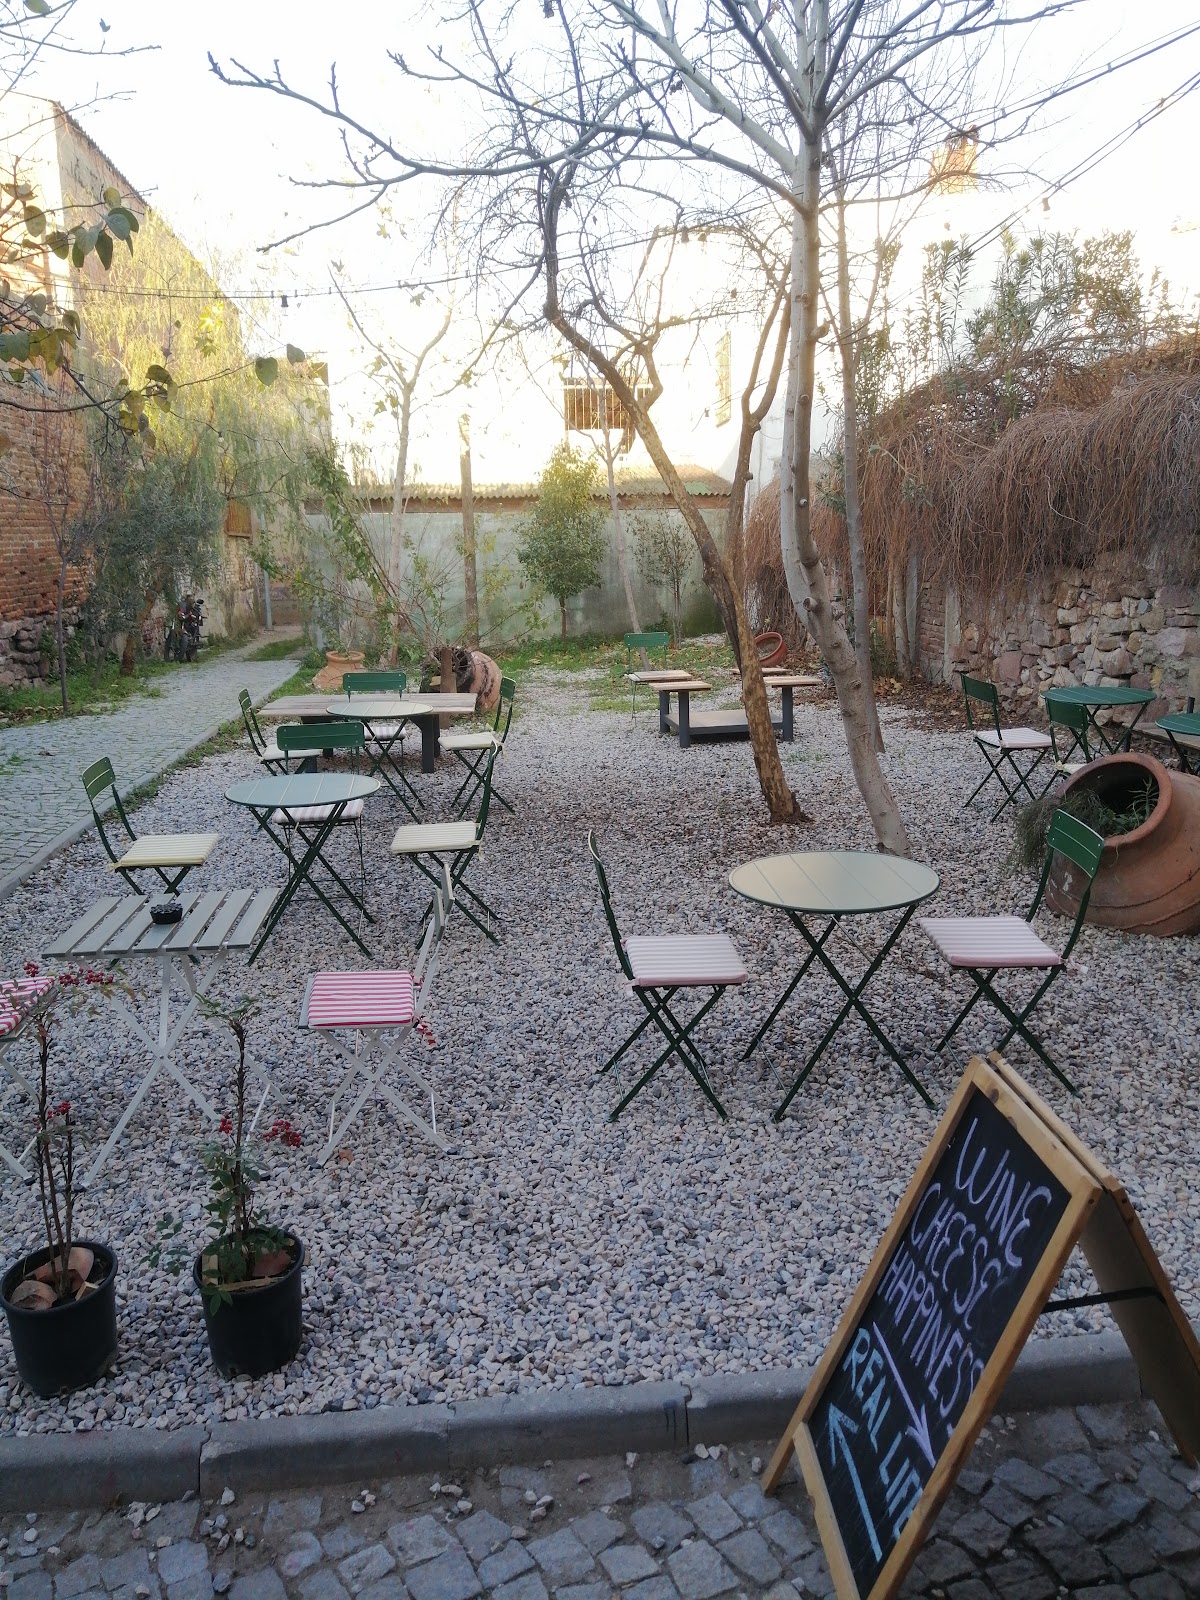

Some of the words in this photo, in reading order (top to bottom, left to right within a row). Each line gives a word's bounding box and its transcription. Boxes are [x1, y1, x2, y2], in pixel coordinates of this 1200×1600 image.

[911, 1182, 1002, 1331] CHEESE
[955, 1117, 1052, 1268] WINE
[842, 1327, 891, 1453] REAL
